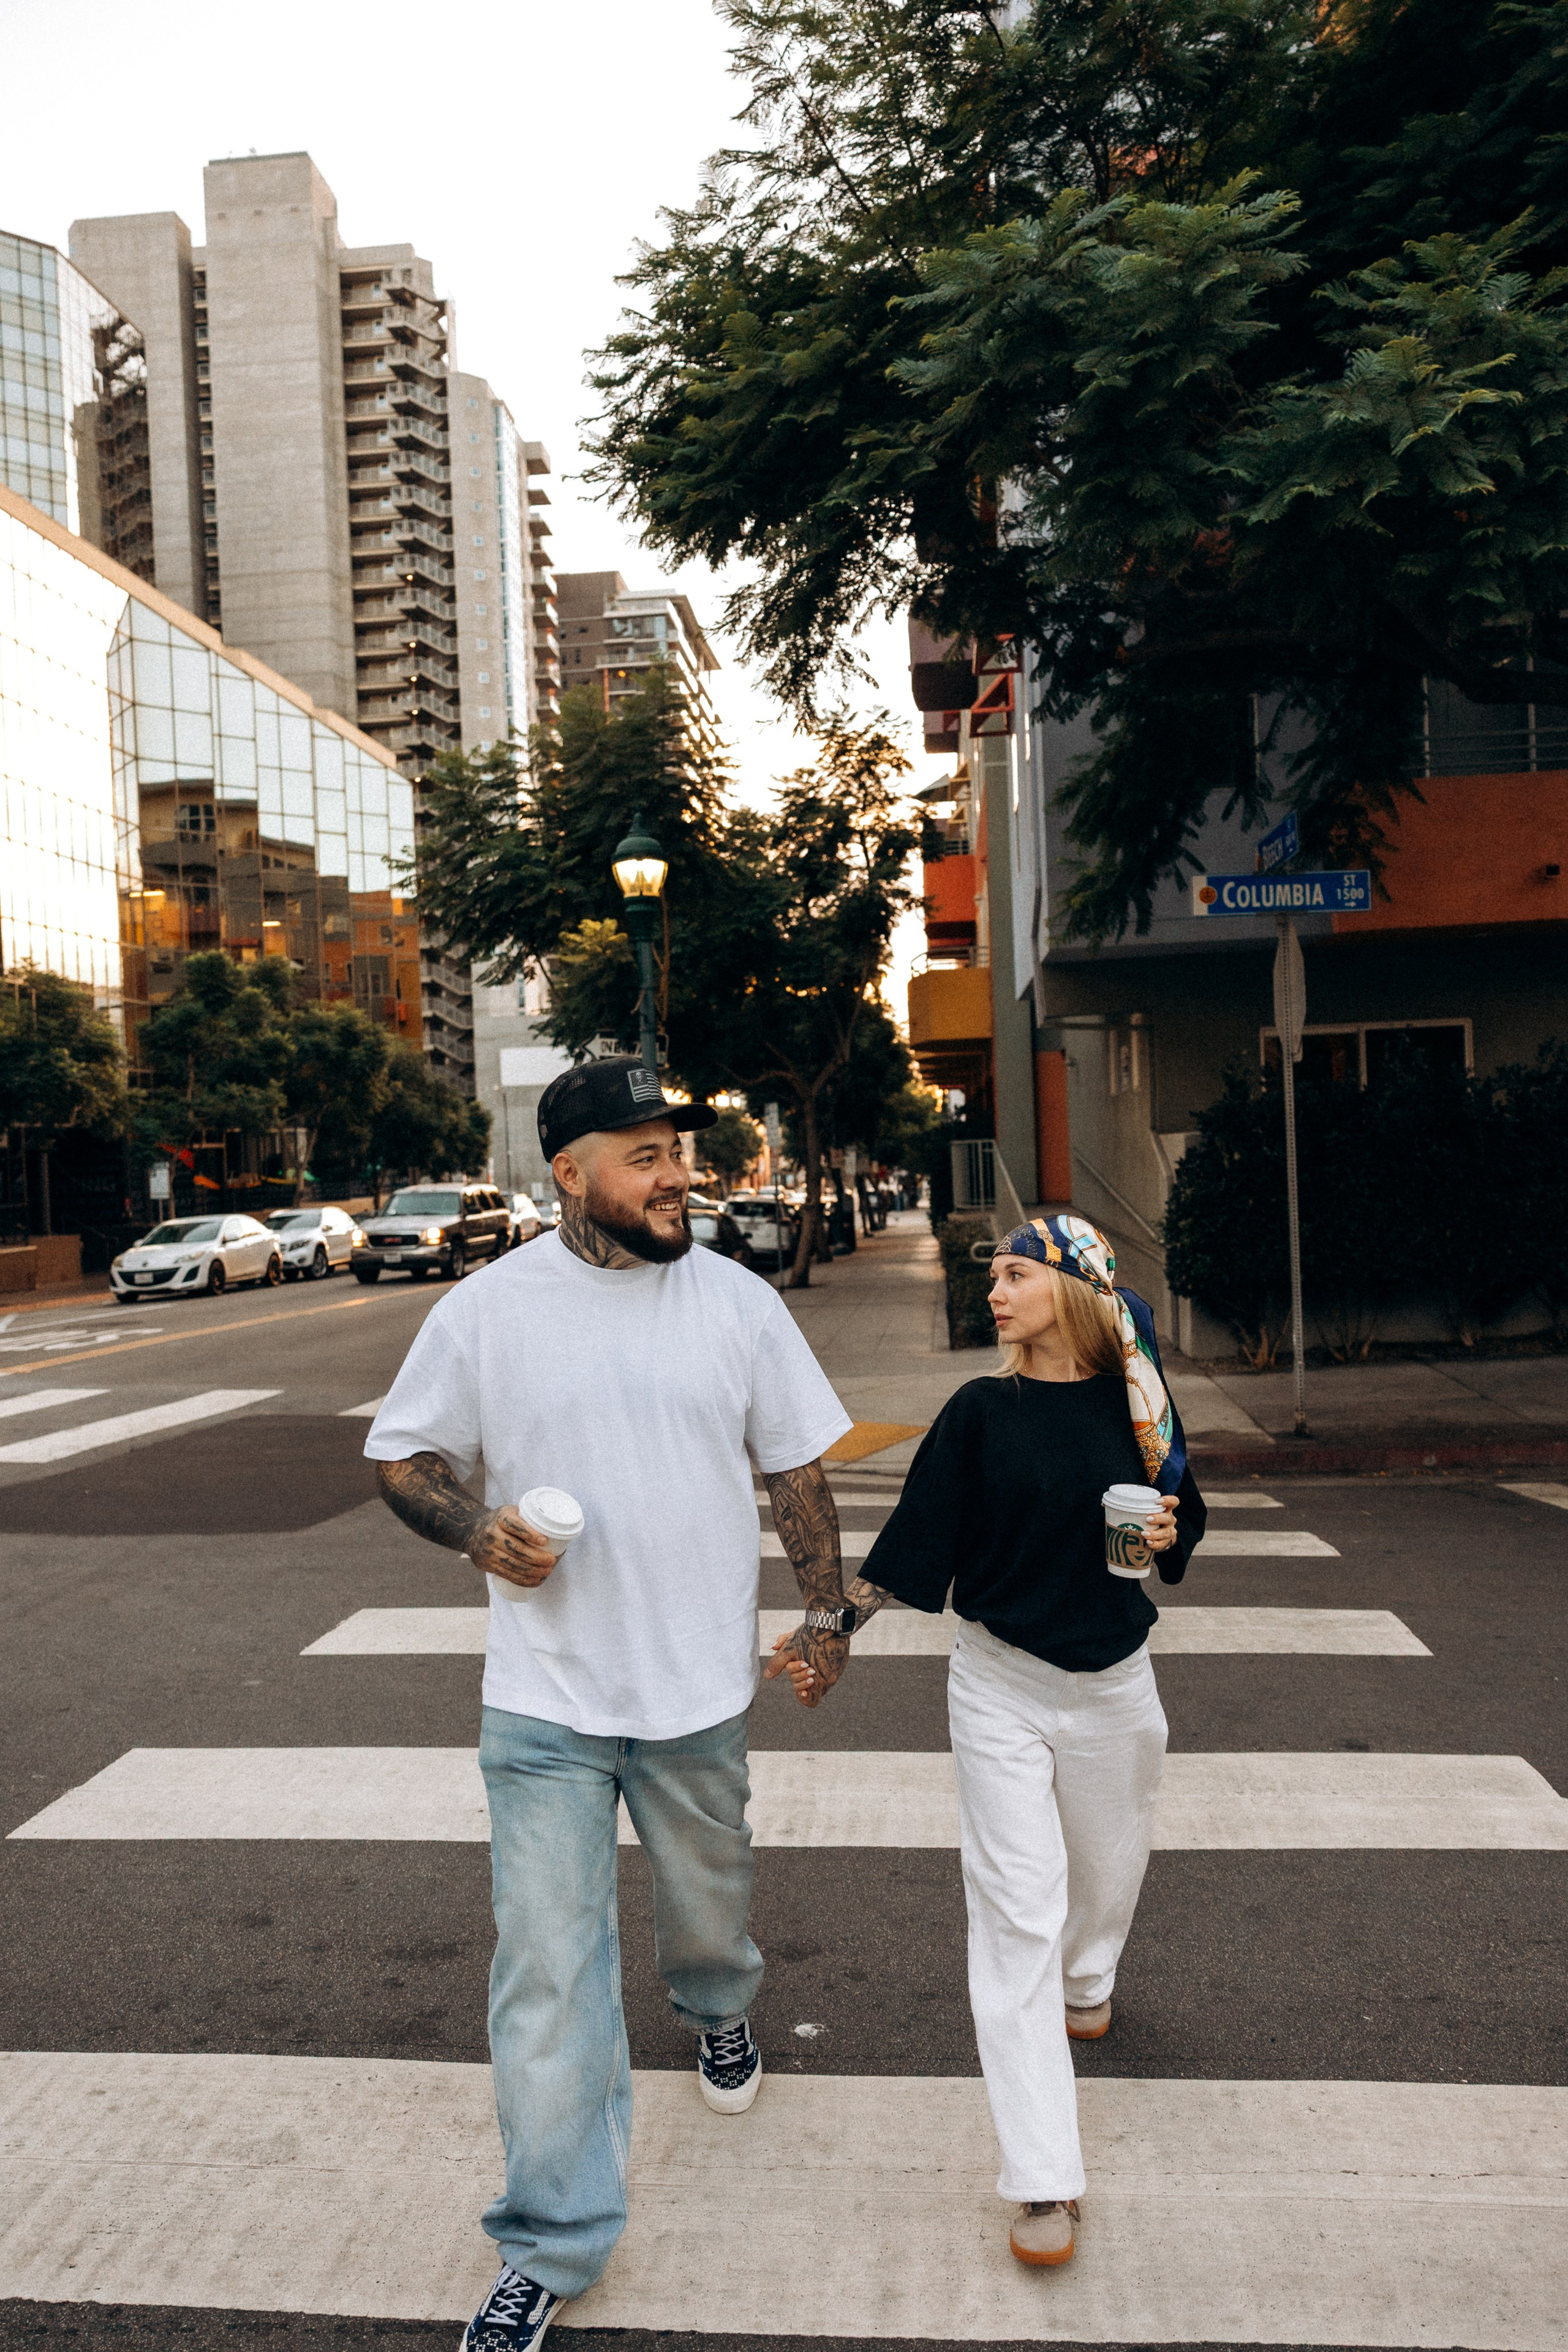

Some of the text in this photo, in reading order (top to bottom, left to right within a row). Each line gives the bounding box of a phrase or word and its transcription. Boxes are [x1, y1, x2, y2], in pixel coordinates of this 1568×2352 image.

[1343, 875, 1356, 887] ST
[1222, 881, 1325, 909] COLUMBIA
[1337, 888, 1365, 900] 1500
